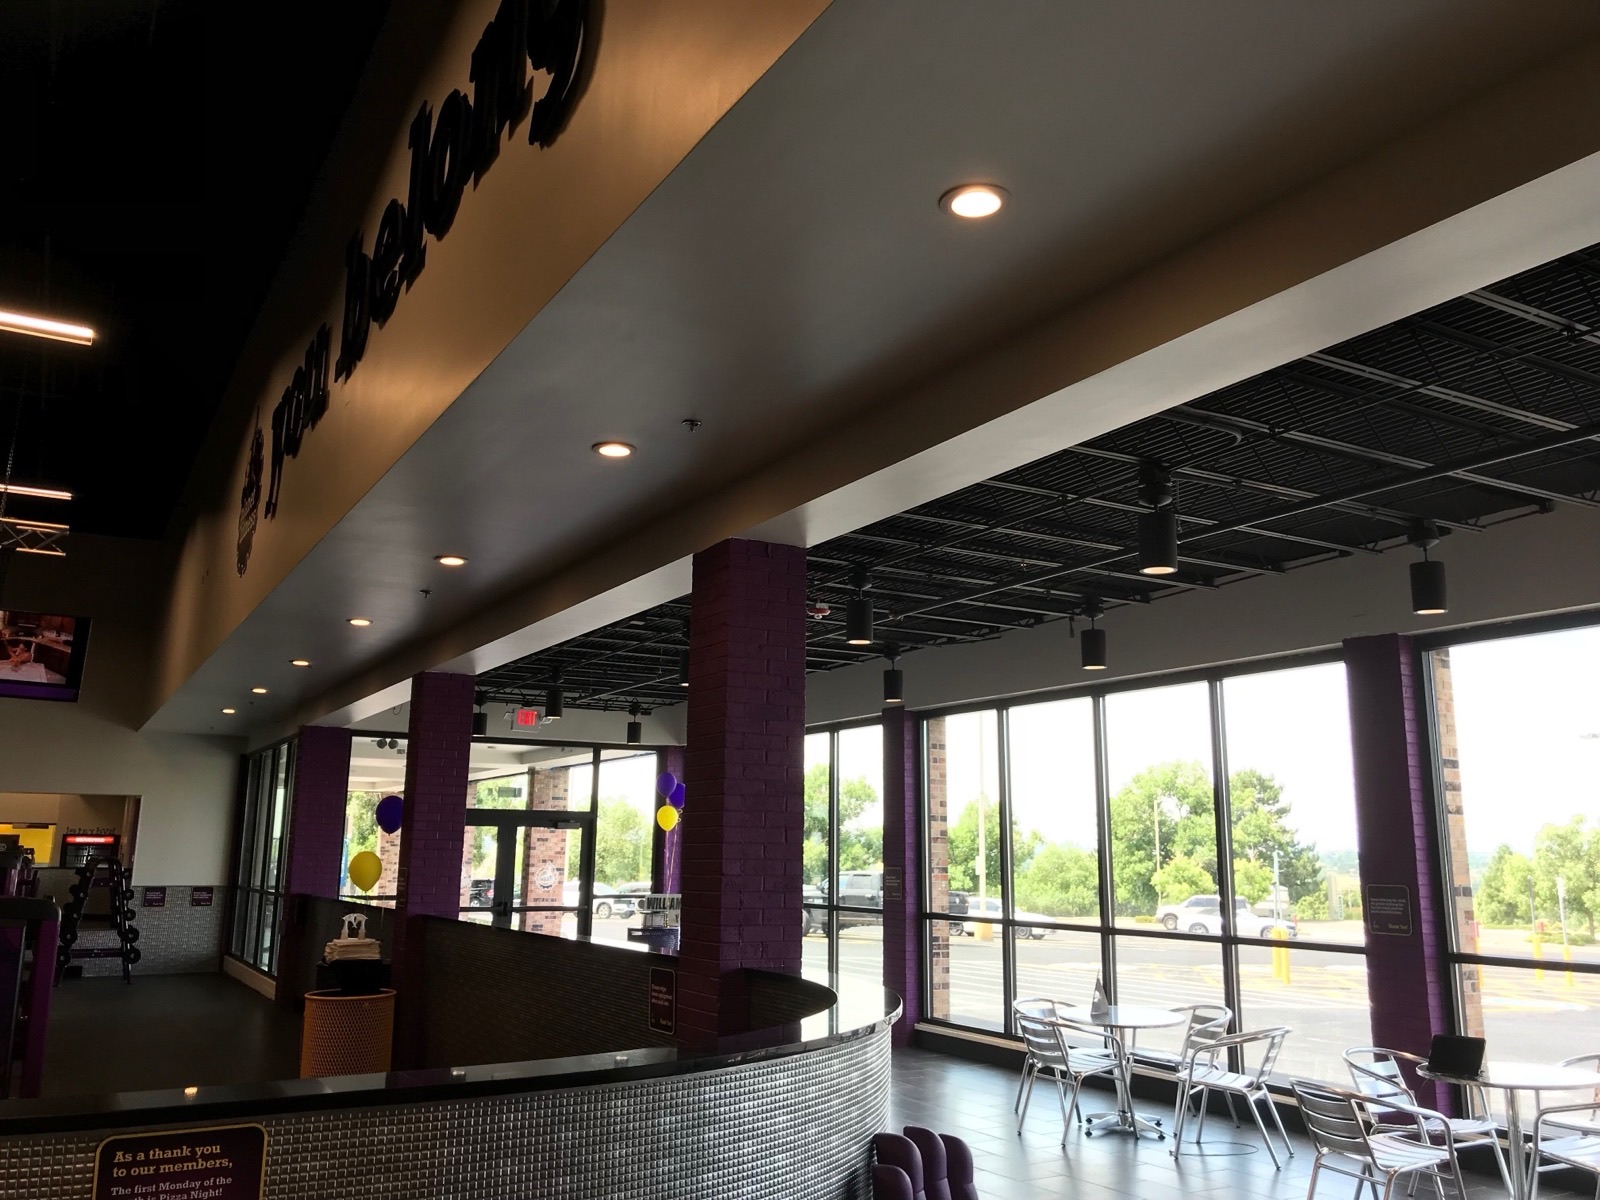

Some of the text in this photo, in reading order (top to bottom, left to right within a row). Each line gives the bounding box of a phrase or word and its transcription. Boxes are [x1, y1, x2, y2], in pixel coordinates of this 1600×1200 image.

[264, 322, 330, 520] you
[517, 709, 537, 726] EXIT
[113, 1144, 221, 1163] As a thank you
[113, 1158, 233, 1178] to our members,
[110, 1176, 232, 1196] The first Monday of the
[190, 1187, 223, 1200] Night!
